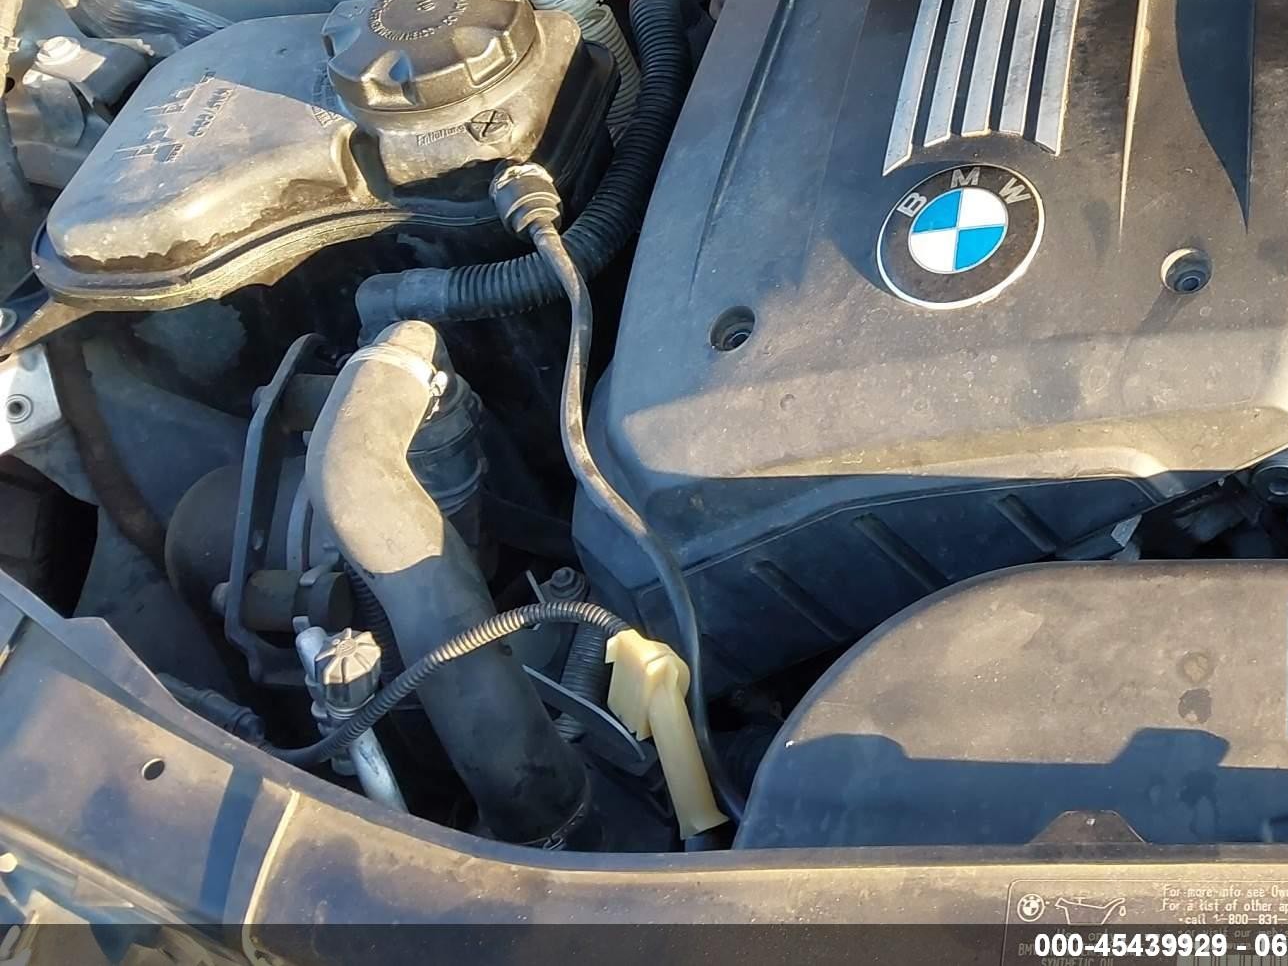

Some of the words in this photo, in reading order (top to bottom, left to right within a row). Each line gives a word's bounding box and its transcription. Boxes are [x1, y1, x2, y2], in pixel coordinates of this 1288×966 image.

[896, 167, 1032, 218] BMW
[1163, 884, 1180, 897] For
[1187, 888, 1212, 897] more
[1247, 888, 1264, 897] see
[1162, 898, 1180, 911] For
[1199, 899, 1219, 911] list
[1225, 899, 1238, 911] of
[1244, 899, 1272, 911] other
[1185, 914, 1206, 925] call
